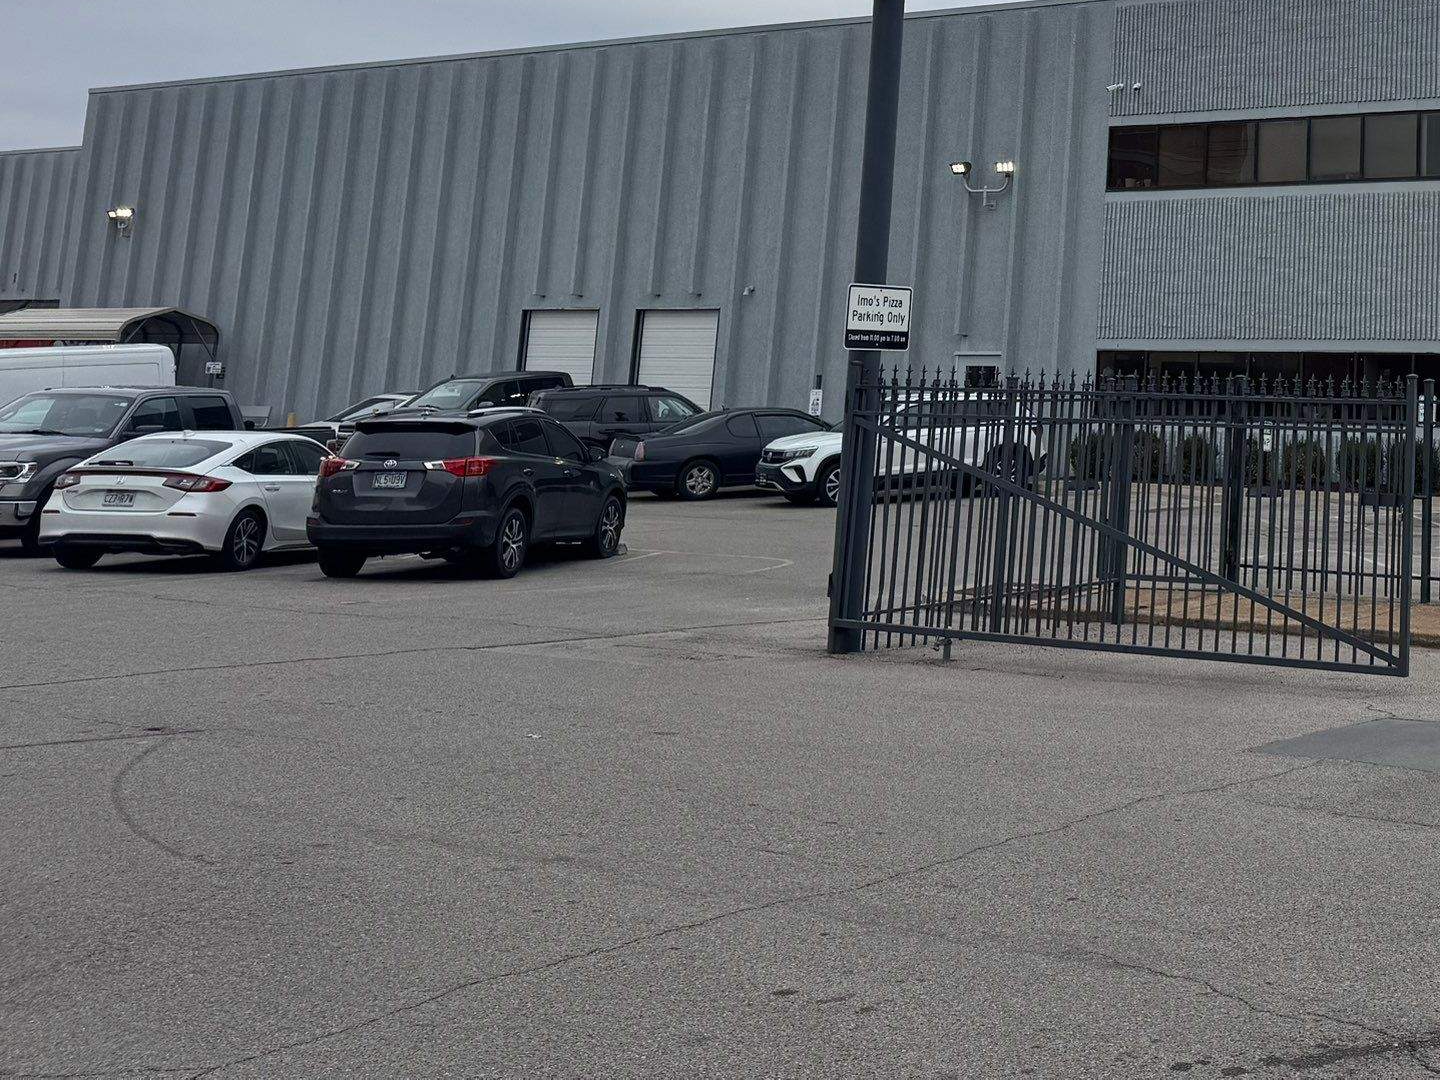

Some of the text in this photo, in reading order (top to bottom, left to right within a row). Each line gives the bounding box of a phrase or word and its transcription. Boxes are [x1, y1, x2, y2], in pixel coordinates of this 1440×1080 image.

[857, 294, 903, 308] Imo's Pizza
[852, 310, 906, 326] Parking Only
